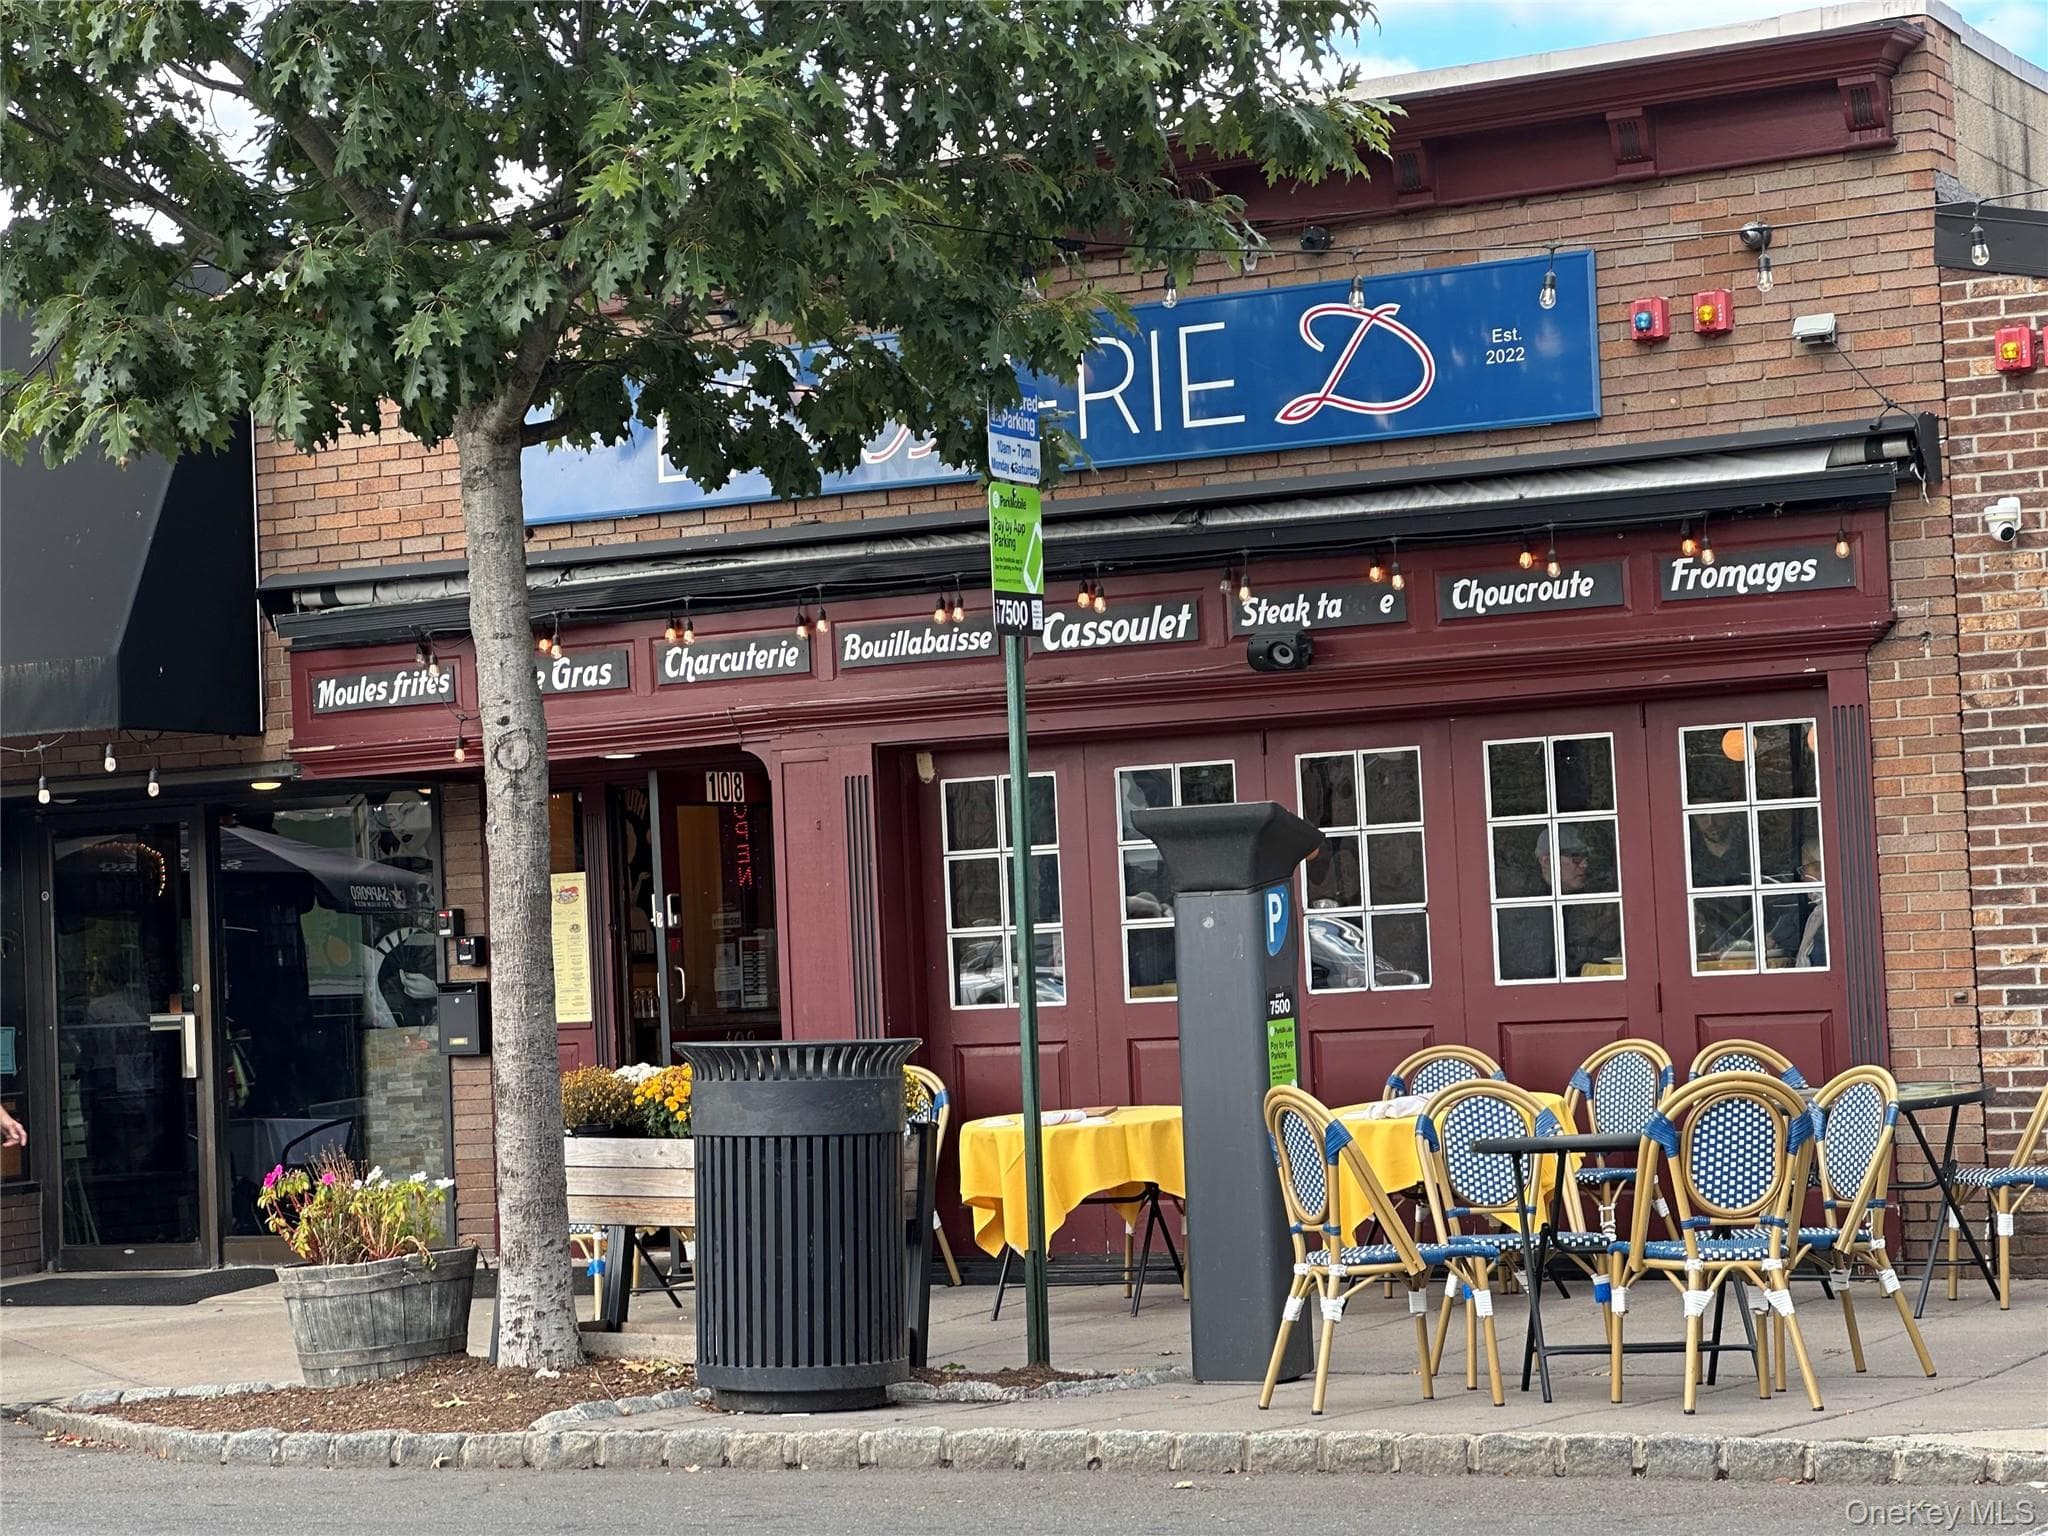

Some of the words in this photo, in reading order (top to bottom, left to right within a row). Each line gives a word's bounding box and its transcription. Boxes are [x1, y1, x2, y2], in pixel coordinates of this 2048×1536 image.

[1491, 327, 1523, 344] Est.
[1485, 346, 1526, 366] 2022
[1002, 408, 1036, 437] Parking
[991, 456, 1010, 474] Monday
[1017, 443, 1032, 461] 7pm
[993, 516, 1004, 534] Pay
[1005, 518, 1012, 535] by
[1014, 519, 1026, 537] App
[994, 532, 1017, 552] Parking
[1670, 555, 1819, 595] Fromages
[1452, 569, 1595, 615] Choucroute
[1241, 593, 1312, 627] Steak
[1042, 604, 1193, 653] Cassoulet
[842, 627, 993, 662] Bouillabaisse
[552, 656, 612, 691] Gras
[664, 639, 801, 683] Charcuterie
[317, 678, 388, 709] Moules
[388, 671, 451, 705] frites
[708, 771, 744, 802] 108
[1269, 998, 1291, 1015] 7500
